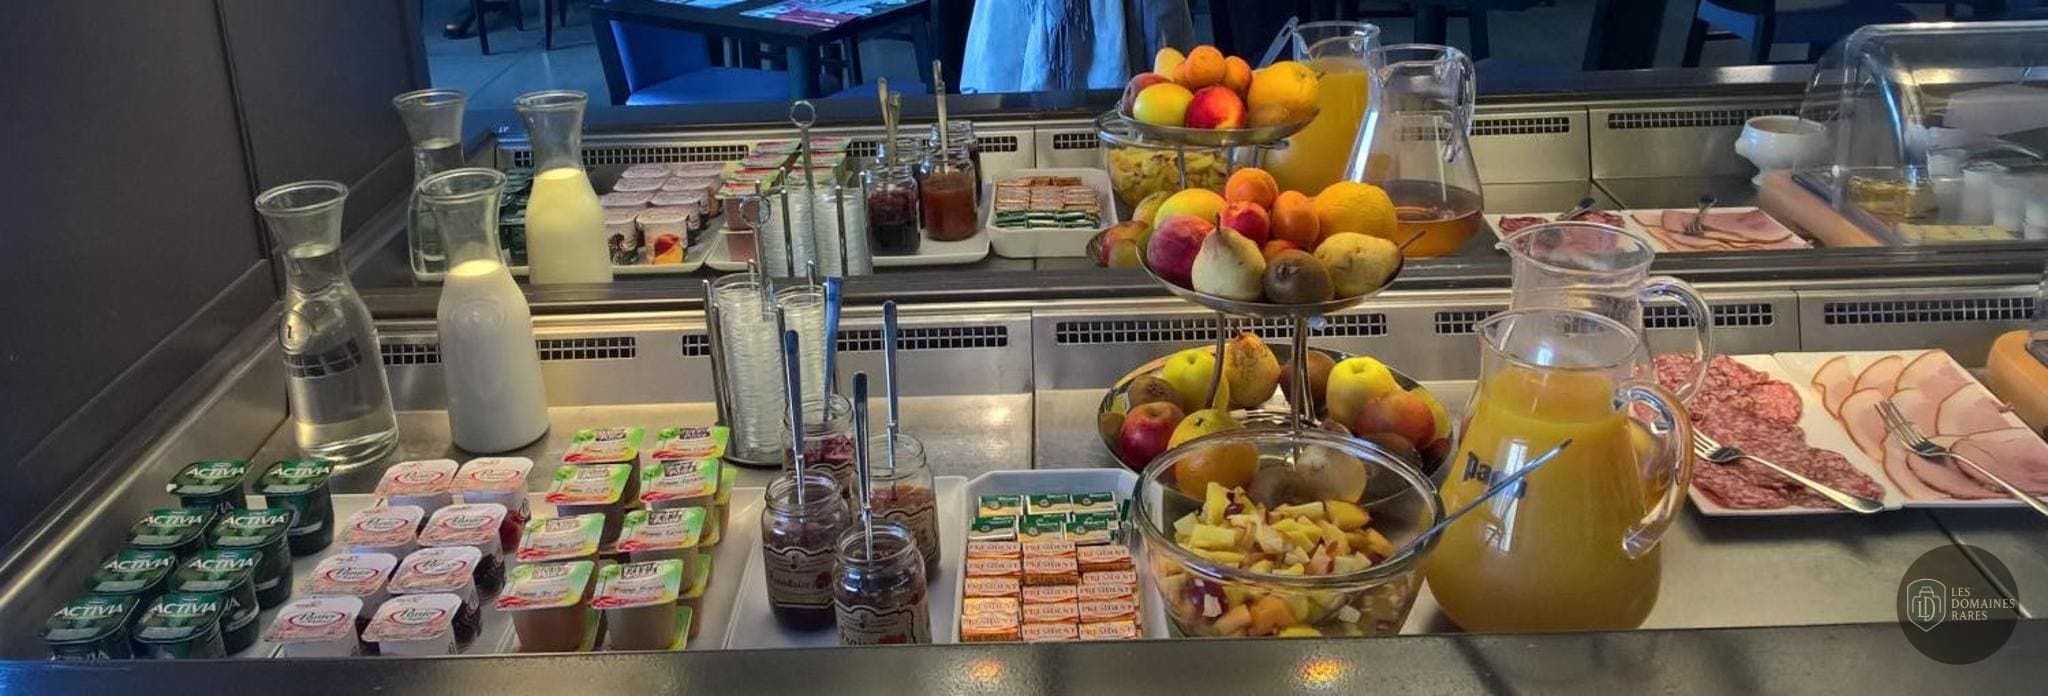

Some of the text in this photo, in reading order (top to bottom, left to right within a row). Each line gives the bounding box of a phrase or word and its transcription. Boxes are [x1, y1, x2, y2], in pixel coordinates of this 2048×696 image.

[185, 467, 244, 478] ACTIVIA
[270, 466, 329, 478] ACTIVIA
[140, 514, 202, 525] ACTIVIA
[223, 515, 285, 528] ACTIVIA
[104, 556, 170, 570] ACTIVIA
[188, 557, 255, 570] ACTIVIA
[54, 603, 123, 617] ACTIVIA
[150, 602, 217, 615] ACTIVIA
